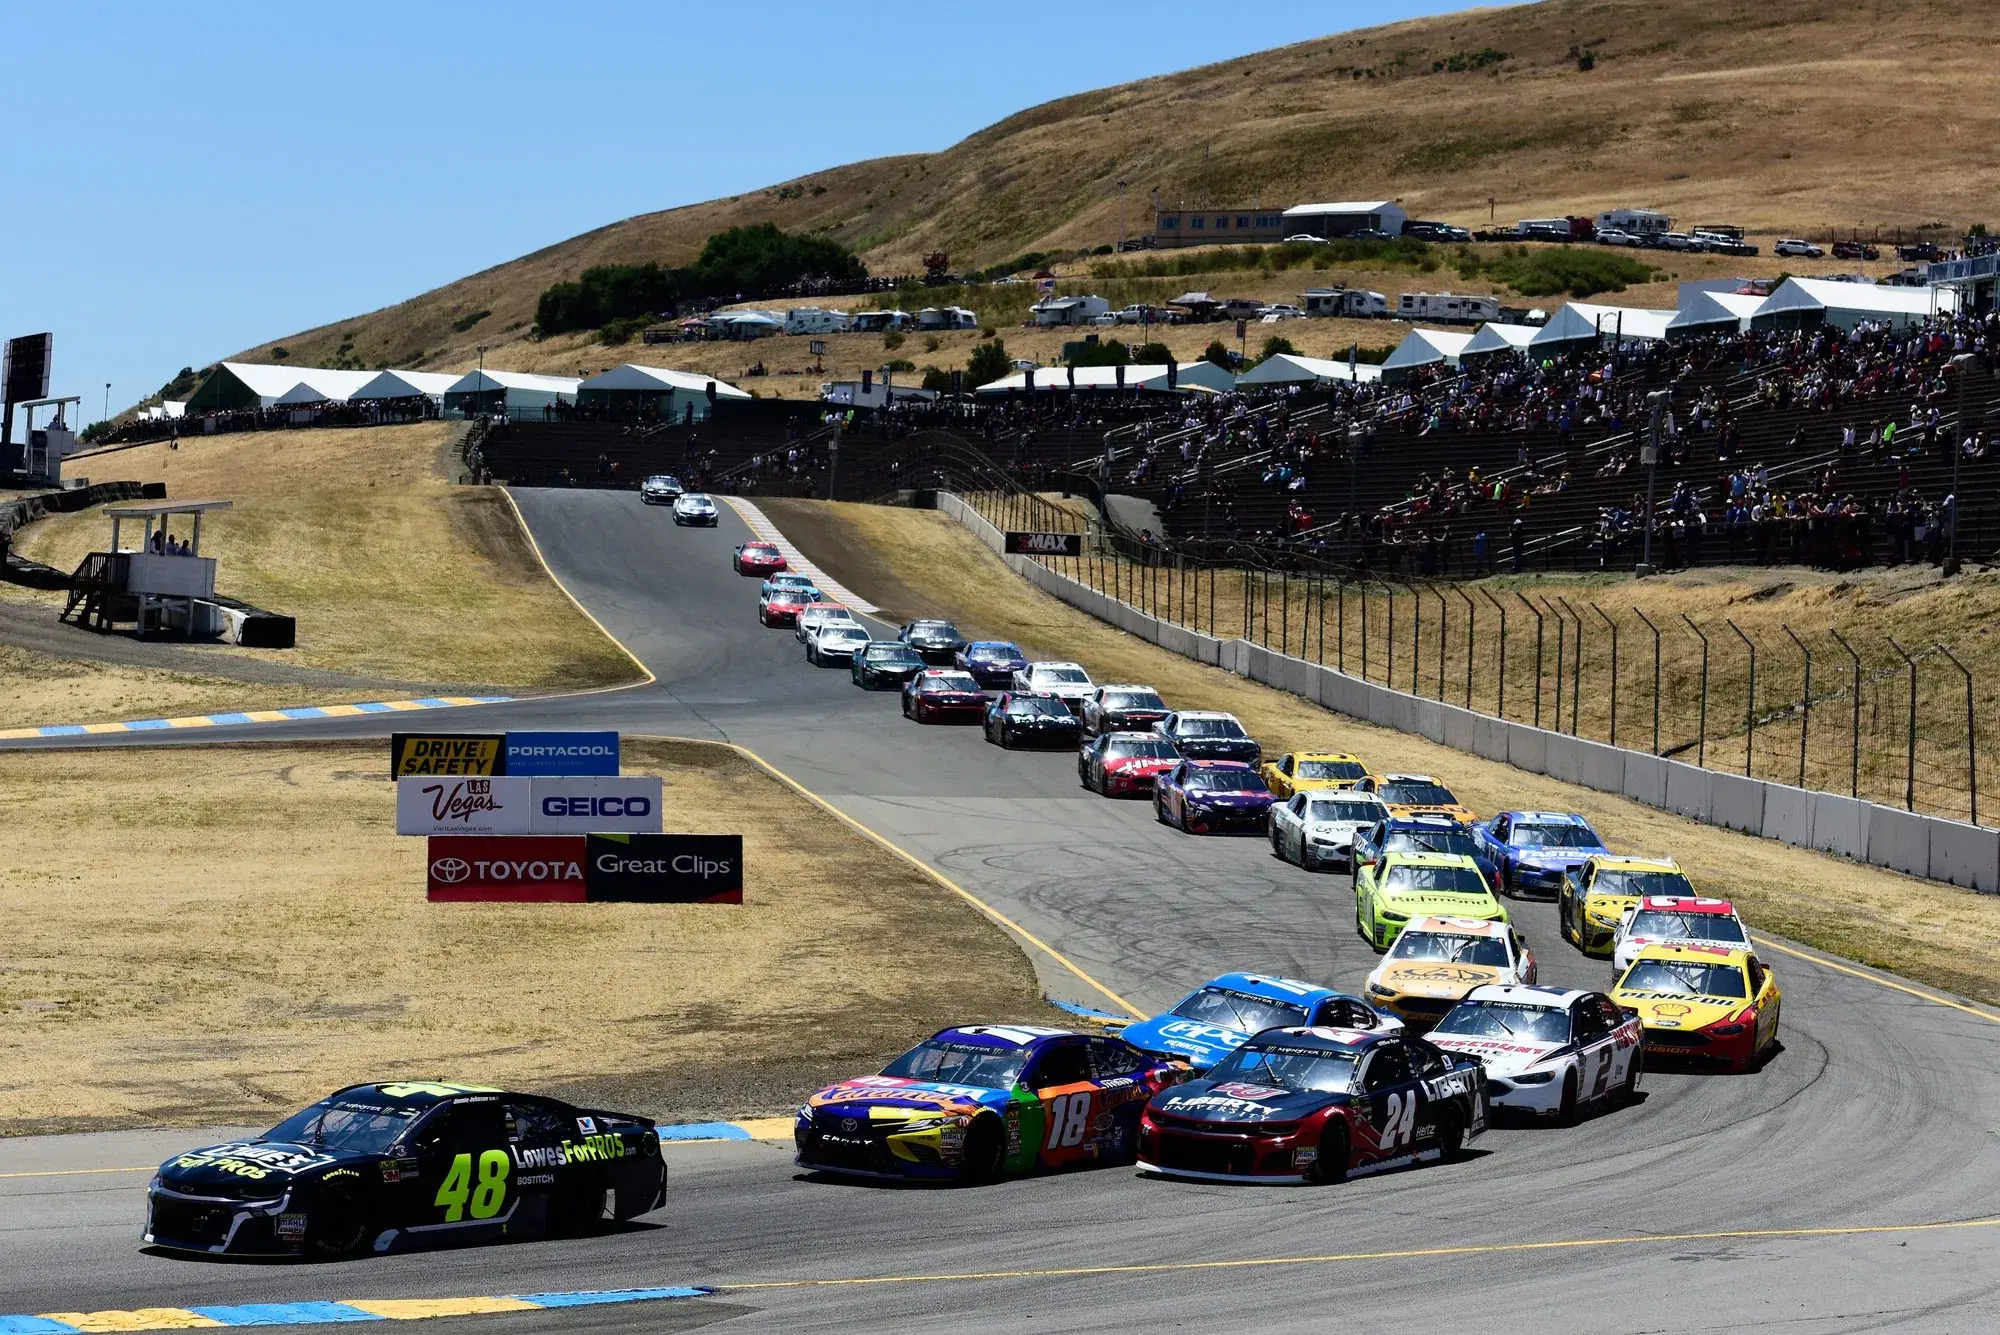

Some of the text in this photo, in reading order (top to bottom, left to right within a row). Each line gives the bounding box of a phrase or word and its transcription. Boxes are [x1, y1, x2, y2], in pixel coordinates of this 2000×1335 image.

[414, 741, 480, 757] DRIVE
[508, 746, 614, 756] PORTACOOL
[403, 758, 488, 775] SAFETY
[468, 781, 489, 793] LAS
[422, 782, 504, 823] Vegas
[542, 797, 651, 817] GEICO
[474, 861, 584, 880] TOYOTA
[596, 854, 731, 880] Great Clips
[1391, 896, 1488, 906] Richmond
[1619, 991, 1736, 1006] PENNZOIL
[1592, 1044, 1613, 1098] 2
[1420, 1067, 1478, 1102] LIBERTY
[1162, 1104, 1270, 1121] UNIVERSITY
[1166, 1097, 1283, 1115] LIBERTY
[1047, 1092, 1091, 1149] 18
[1380, 1090, 1416, 1150] 24
[1415, 1124, 1436, 1137] Hertz
[208, 1158, 273, 1179] PROS
[322, 1168, 360, 1180] GOODYEAR
[433, 1149, 511, 1223] 48
[517, 1174, 555, 1186] BOSTITCH
